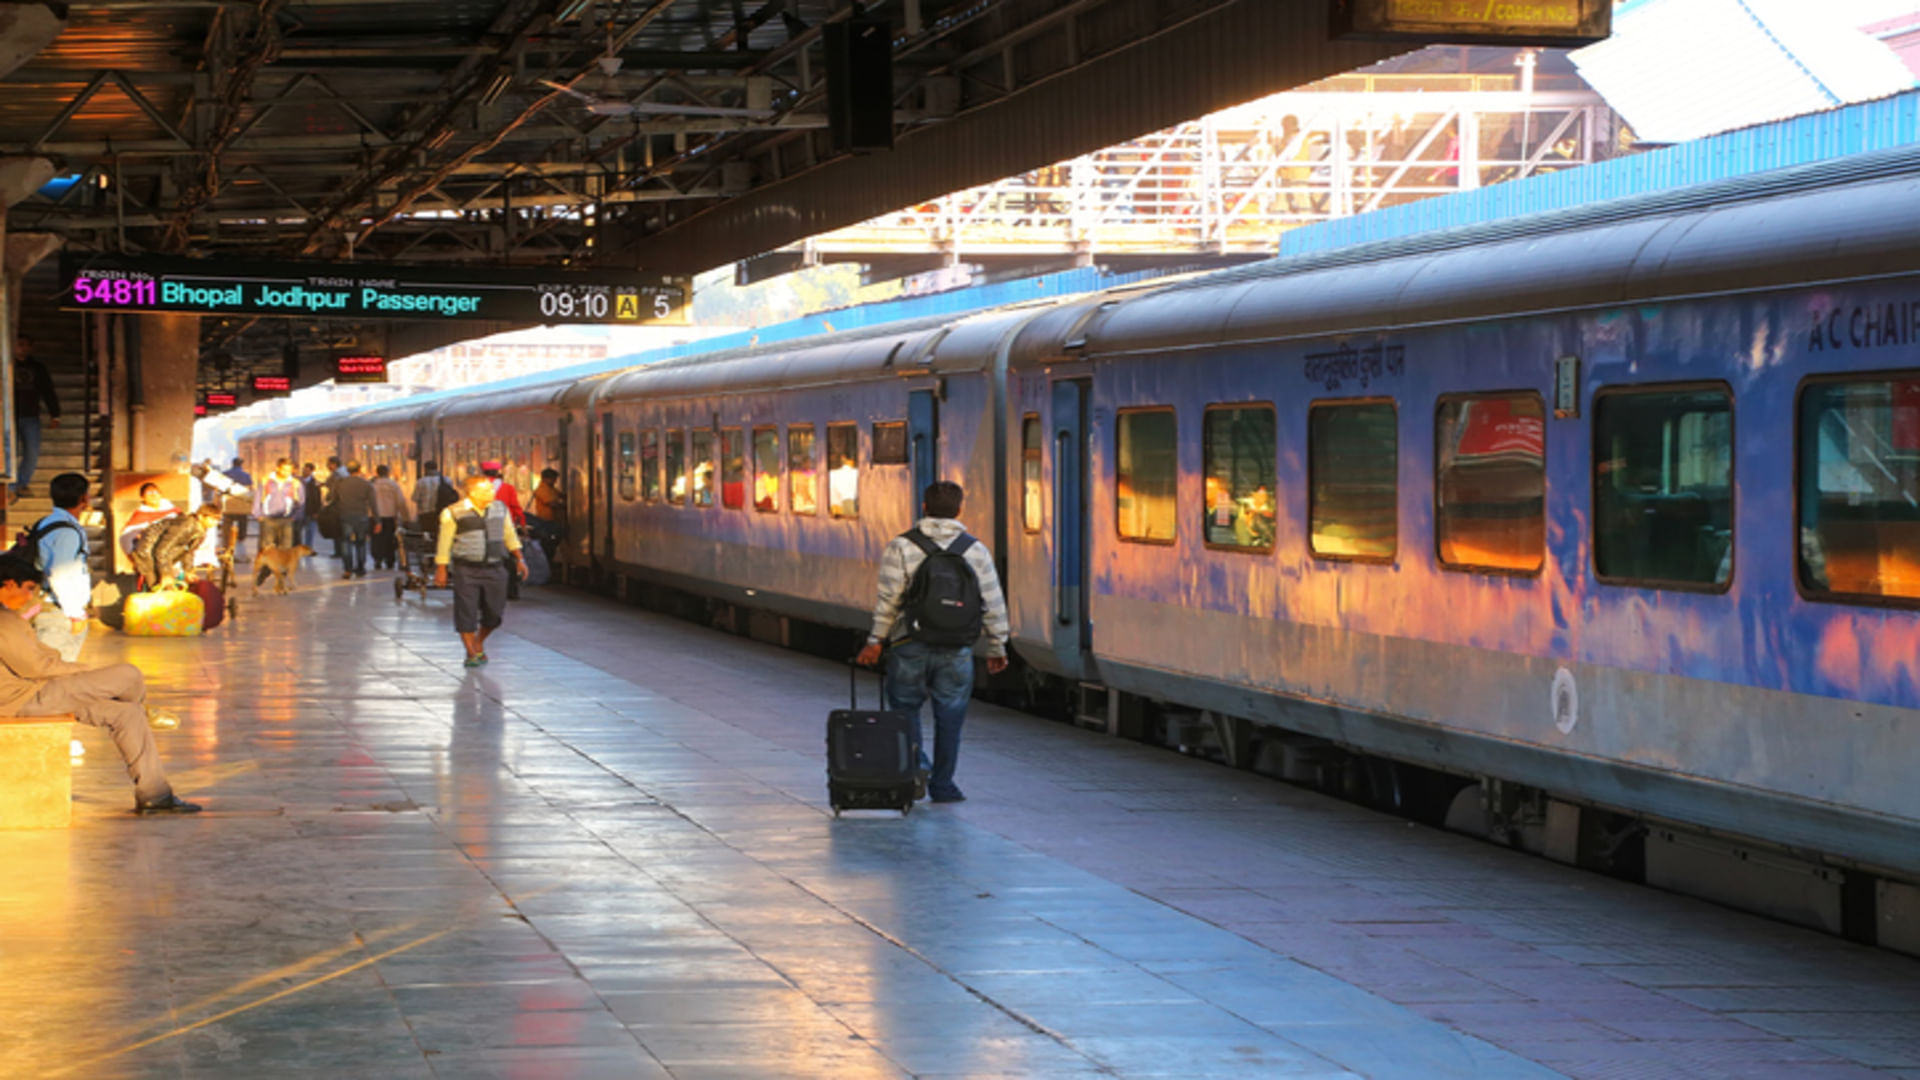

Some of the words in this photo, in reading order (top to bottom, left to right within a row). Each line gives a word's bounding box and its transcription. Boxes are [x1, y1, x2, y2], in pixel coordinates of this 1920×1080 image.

[80, 270, 126, 280] TRAIN
[308, 277, 354, 287] TRAIN
[358, 279, 396, 288] NAME
[74, 278, 156, 305] 54811
[161, 281, 243, 308] Bhopal
[254, 285, 350, 310] Jodhpur
[361, 288, 481, 315] Passenger
[539, 293, 609, 317] 09:10
[617, 296, 636, 317] A
[653, 295, 670, 319] 5
